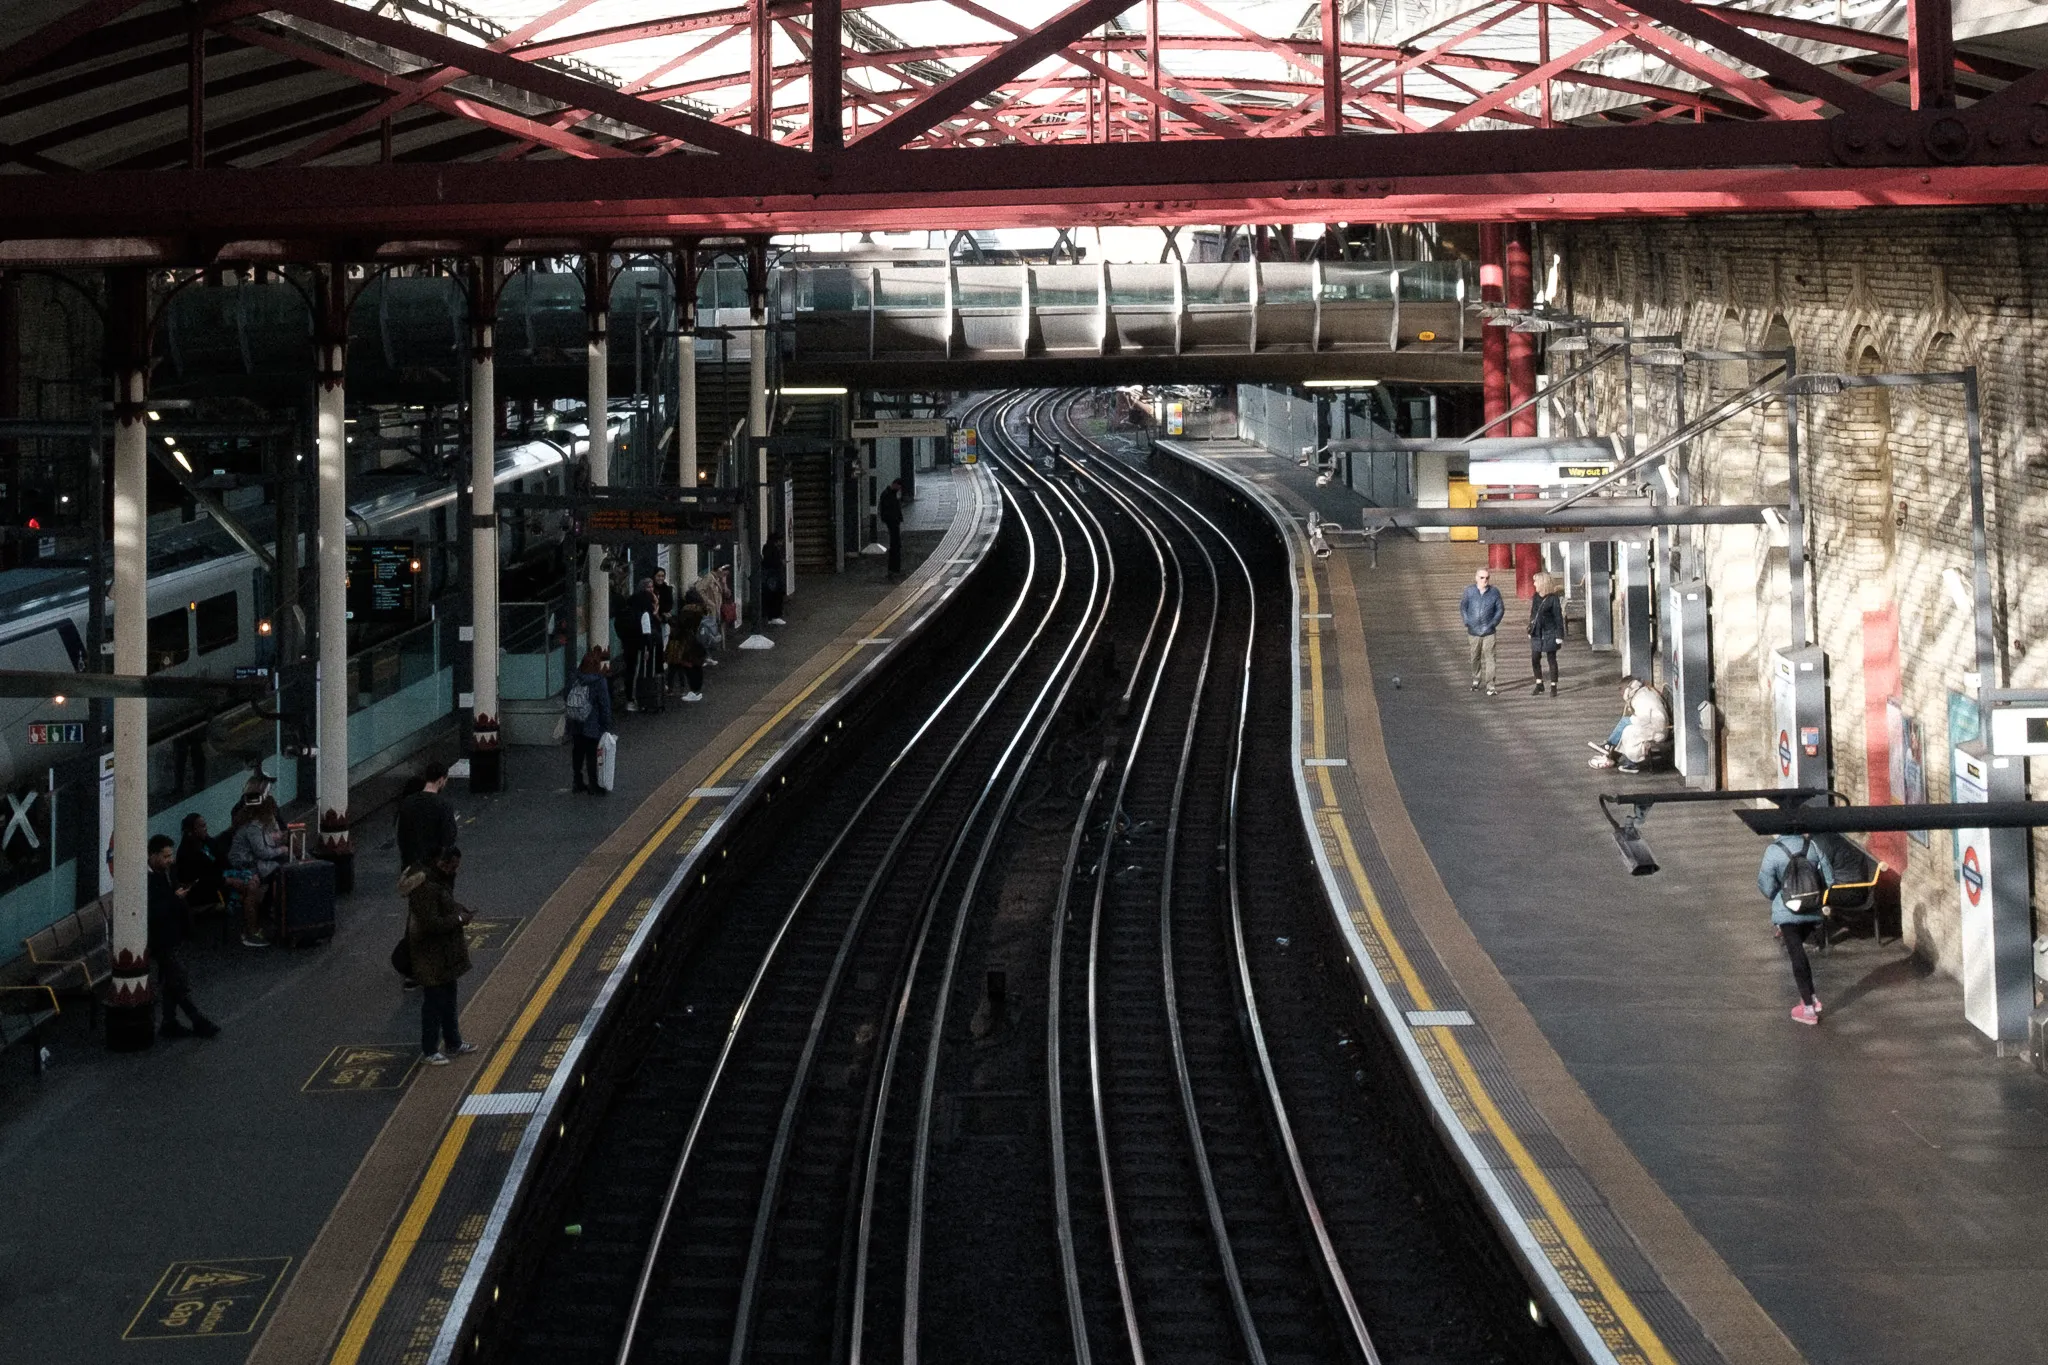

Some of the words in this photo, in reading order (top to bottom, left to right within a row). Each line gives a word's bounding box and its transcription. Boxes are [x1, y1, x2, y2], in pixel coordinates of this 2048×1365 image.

[1568, 467, 1585, 477] Way
[1586, 468, 1600, 476] out
[159, 1301, 205, 1327] Gap
[197, 1300, 233, 1333] Caution
